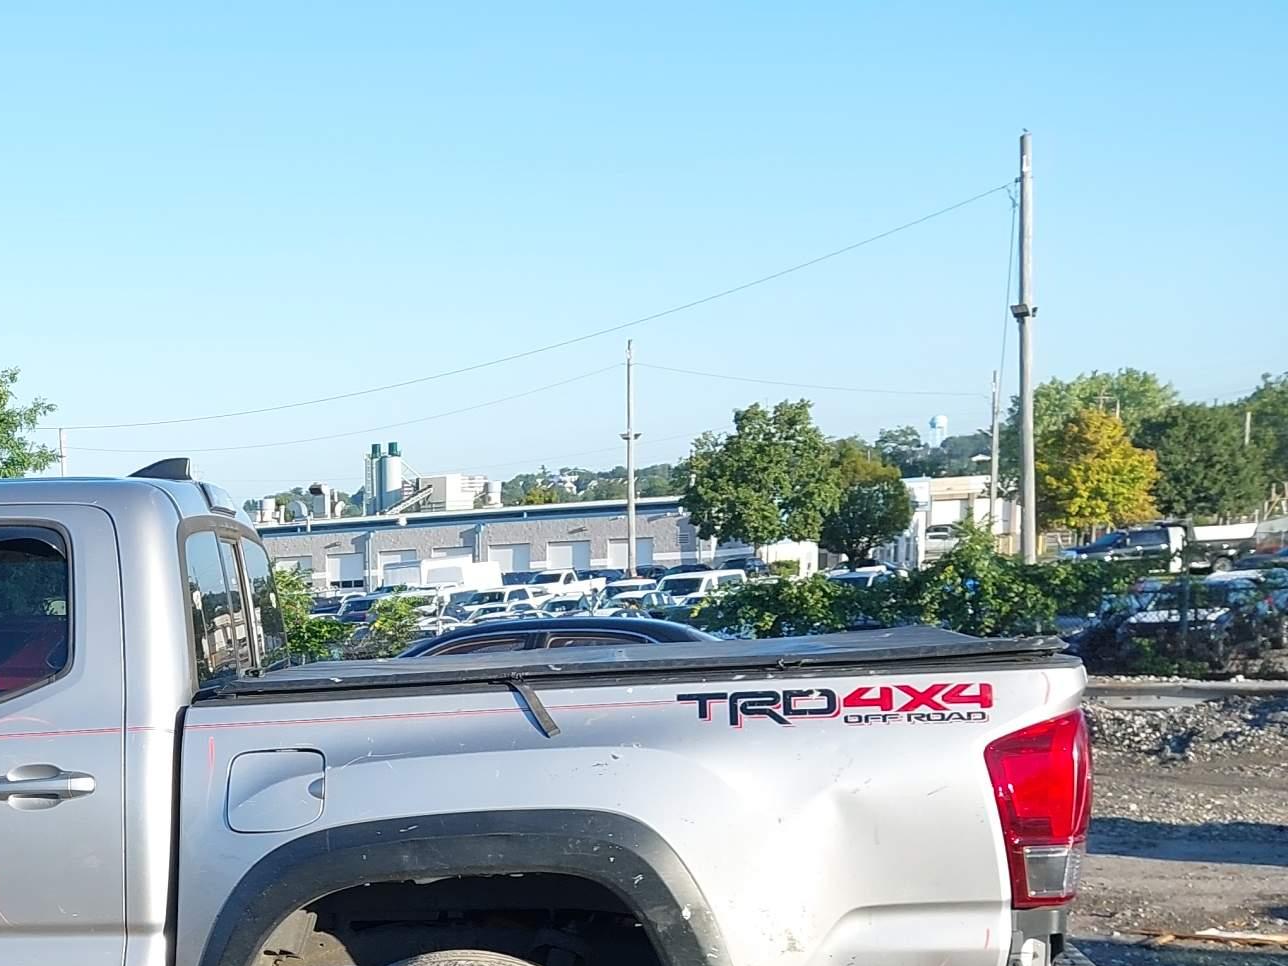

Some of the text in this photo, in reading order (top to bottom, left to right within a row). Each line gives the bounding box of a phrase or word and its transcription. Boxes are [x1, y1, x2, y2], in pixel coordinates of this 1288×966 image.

[677, 683, 993, 728] TRD 4X4
[843, 710, 991, 726] OFF ROAD
